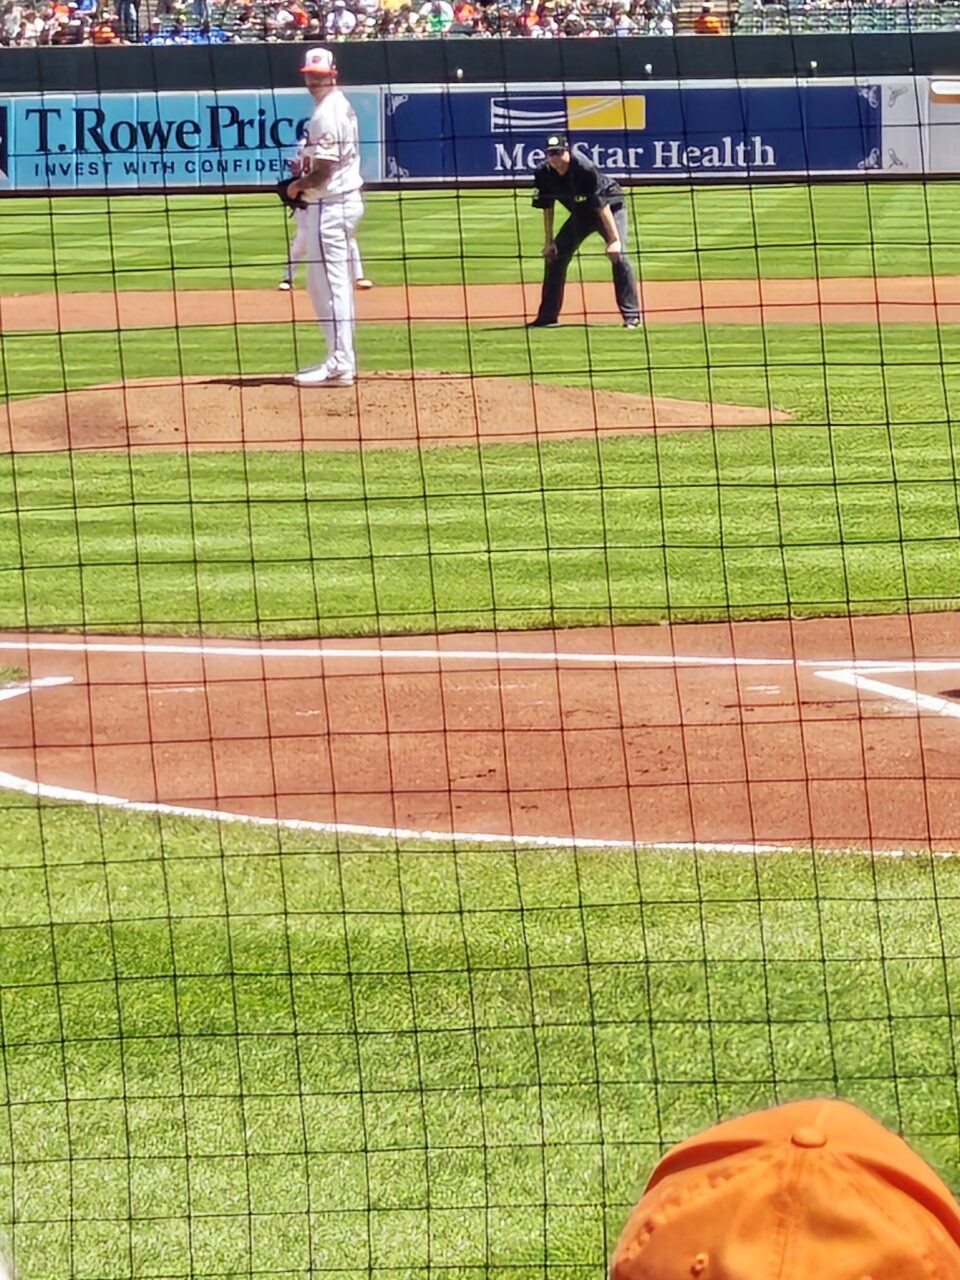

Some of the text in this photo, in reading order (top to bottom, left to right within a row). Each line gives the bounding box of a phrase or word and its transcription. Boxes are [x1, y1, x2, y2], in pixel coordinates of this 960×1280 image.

[495, 135, 776, 170] MeStar Health
[35, 158, 293, 177] INVEST WITH CONFIDE
